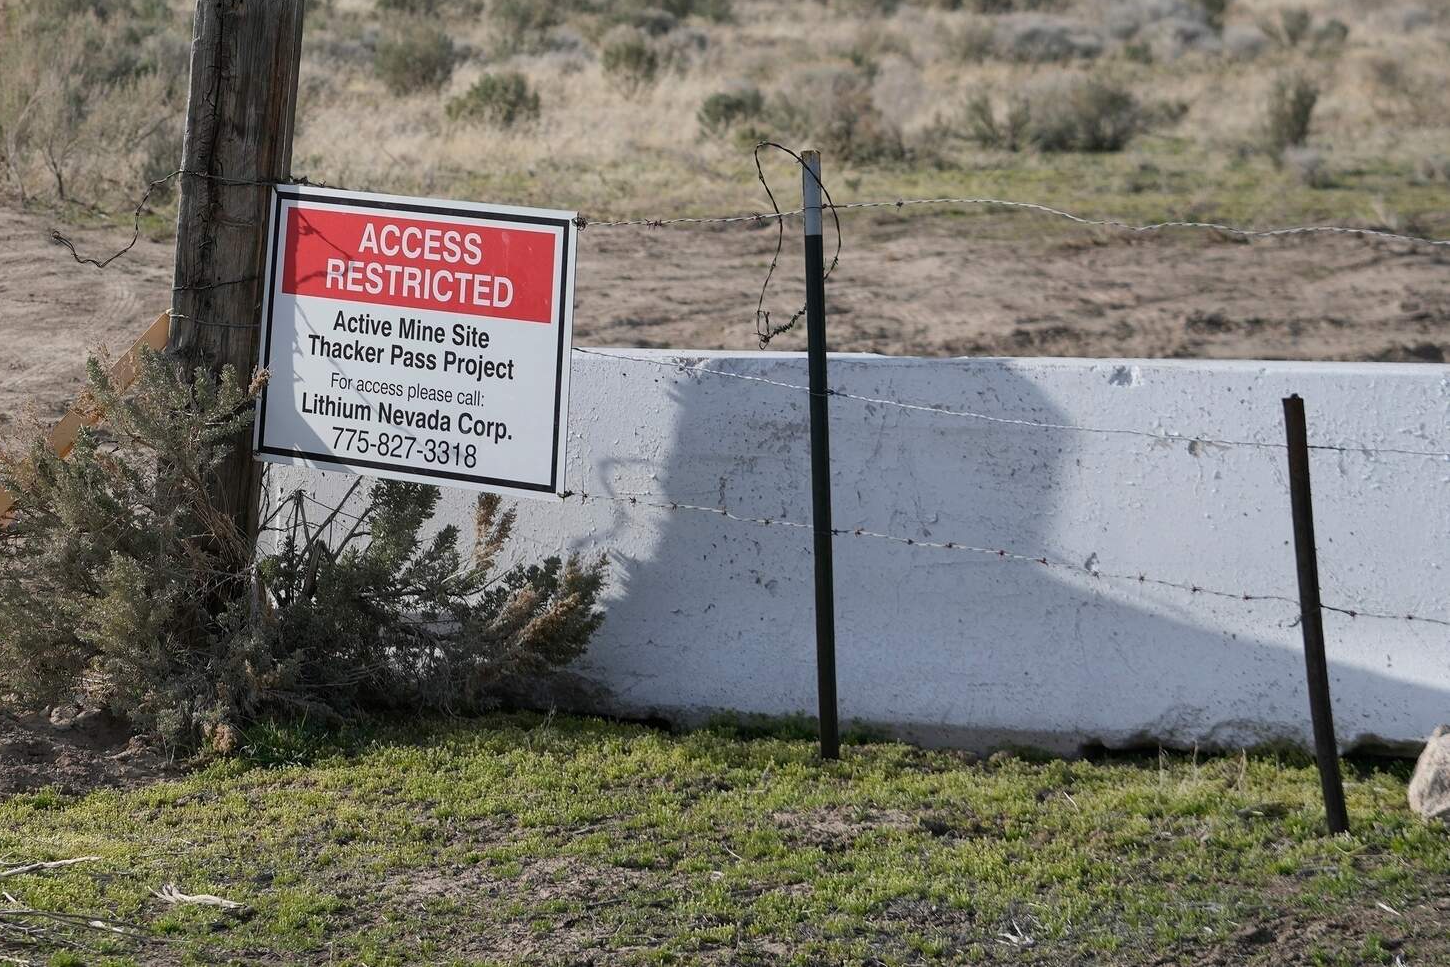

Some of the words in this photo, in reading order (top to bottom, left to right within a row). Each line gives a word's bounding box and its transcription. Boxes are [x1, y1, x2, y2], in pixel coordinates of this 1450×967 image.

[358, 223, 482, 265] ACCESS
[325, 259, 513, 308] RESTRICTED
[333, 311, 392, 337] Active
[399, 318, 445, 343] Mine
[452, 324, 489, 348] Site
[309, 335, 384, 363] Thacker
[391, 345, 436, 370] Pass
[444, 351, 514, 382] Project
[331, 373, 352, 390] For
[356, 378, 403, 396] access
[408, 383, 452, 402] please
[457, 388, 484, 406] call:
[302, 393, 371, 421] Lithium
[379, 402, 450, 432] Nevada
[458, 413, 512, 443] Corp.
[332, 427, 477, 468] 775-827-3318
